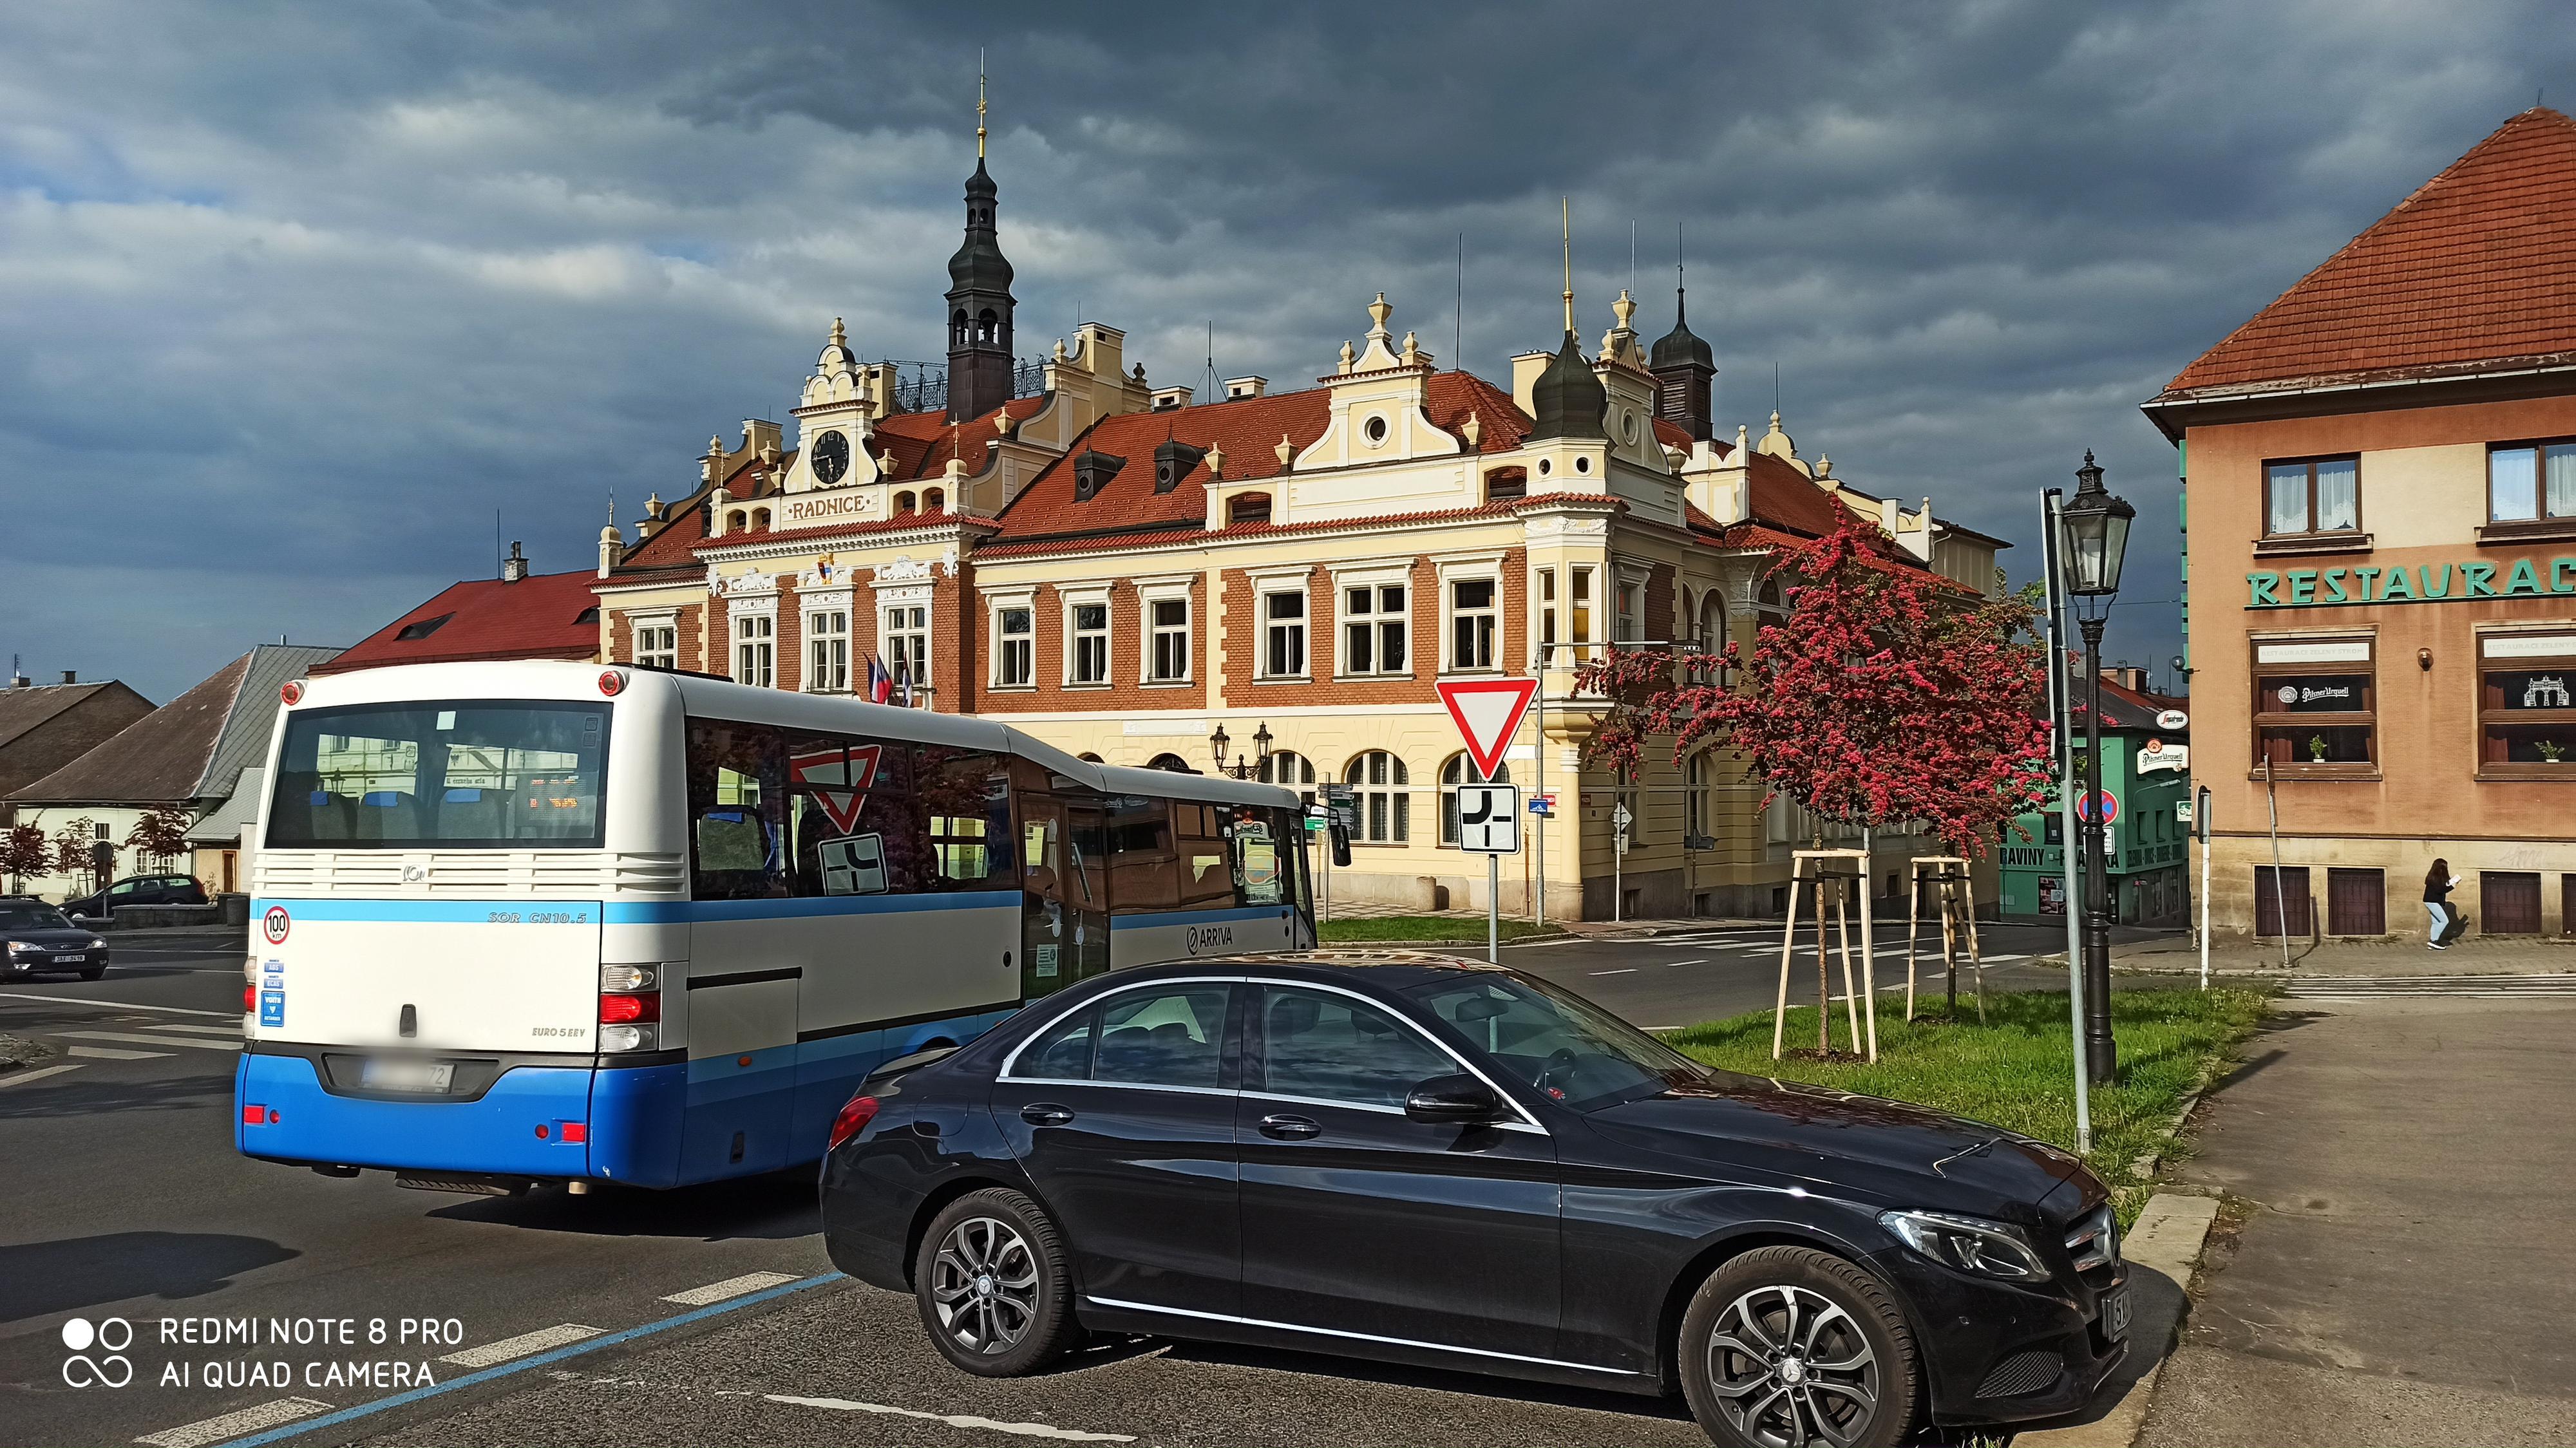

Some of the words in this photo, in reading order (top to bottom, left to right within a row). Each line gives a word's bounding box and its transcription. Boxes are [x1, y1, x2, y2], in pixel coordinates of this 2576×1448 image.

[828, 431, 835, 441] 12
[815, 443, 821, 453] 10
[842, 440, 846, 449] 2
[815, 465, 820, 474] 8
[835, 469, 840, 478] 5
[828, 473, 833, 482] 6
[793, 495, 865, 519] RADNICE
[2246, 558, 2576, 605] RESTAURAC
[488, 912, 521, 923] SOR
[529, 912, 587, 924] CN10.5
[269, 915, 286, 932] 100
[1200, 927, 1233, 948] ARRIVA
[532, 1028, 558, 1037] EURO
[559, 1028, 566, 1037] 5
